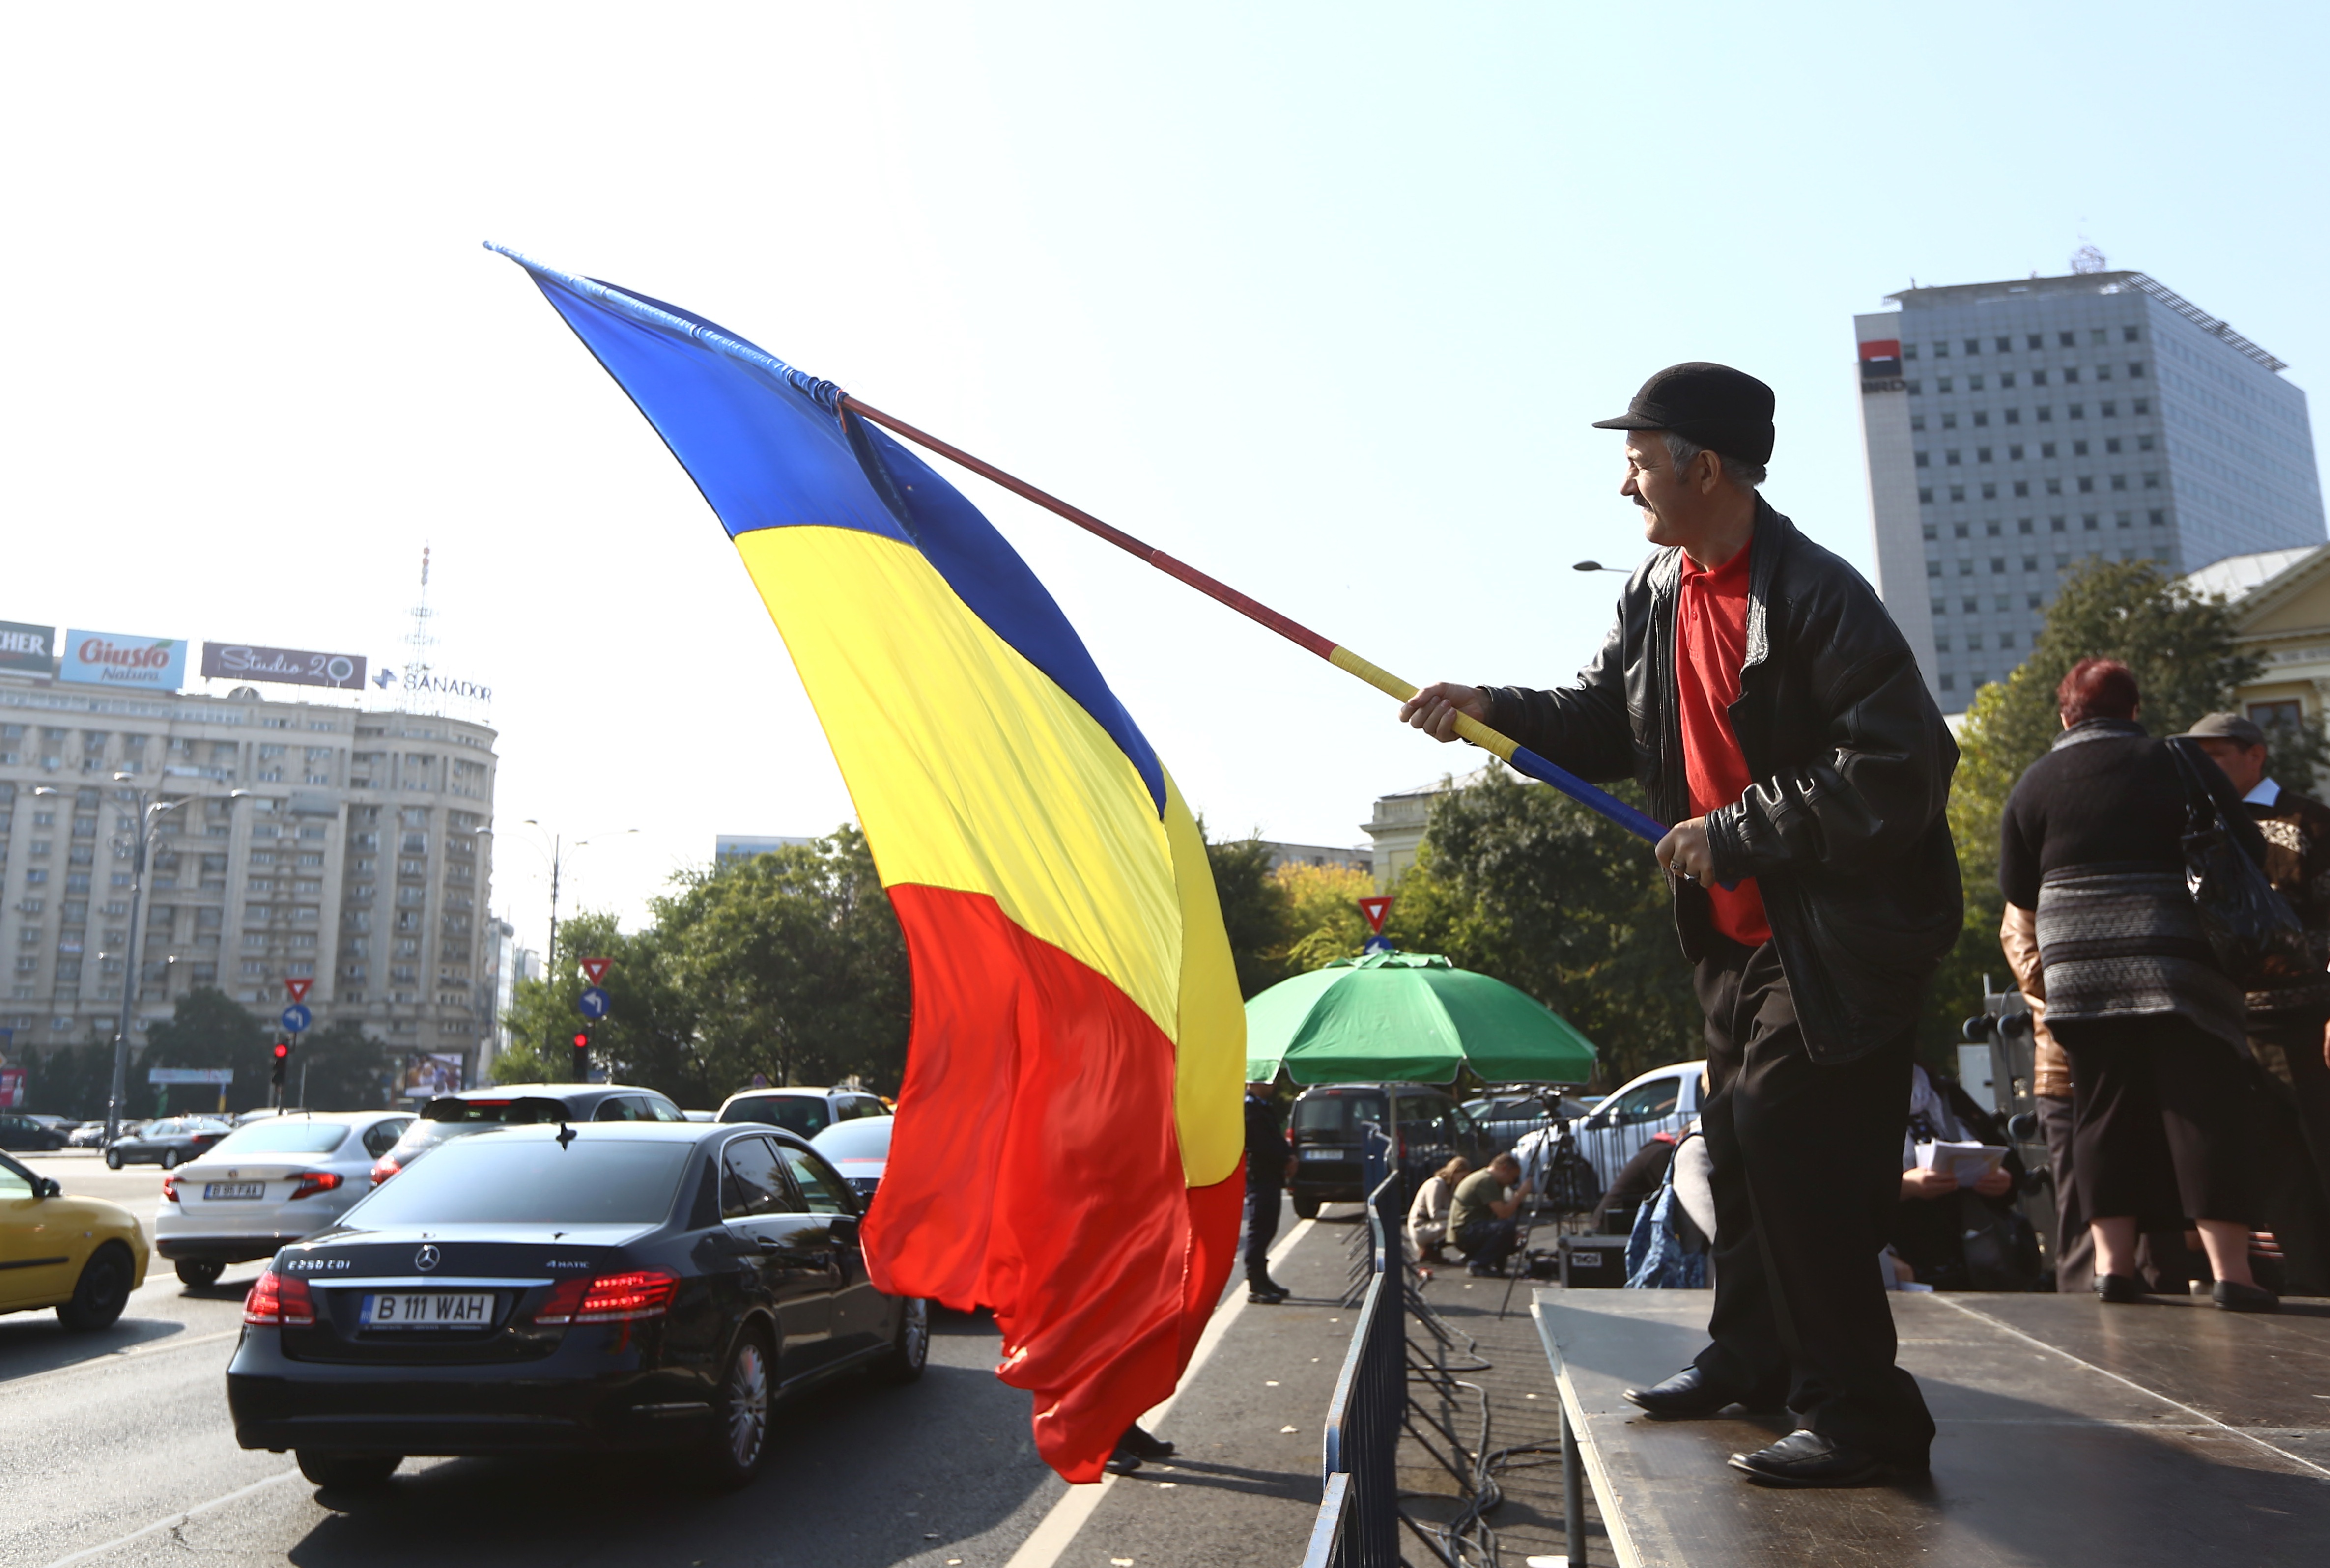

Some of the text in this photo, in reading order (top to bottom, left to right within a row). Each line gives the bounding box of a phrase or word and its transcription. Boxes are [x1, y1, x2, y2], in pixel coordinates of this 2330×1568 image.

[0, 630, 47, 656] HER
[79, 638, 170, 669] Giusto
[101, 666, 161, 681] Natura
[221, 645, 354, 682] Studio 20
[403, 673, 491, 703] SANADOR
[326, 1259, 350, 1270] CDI
[378, 1295, 485, 1321] B 111 WAH
